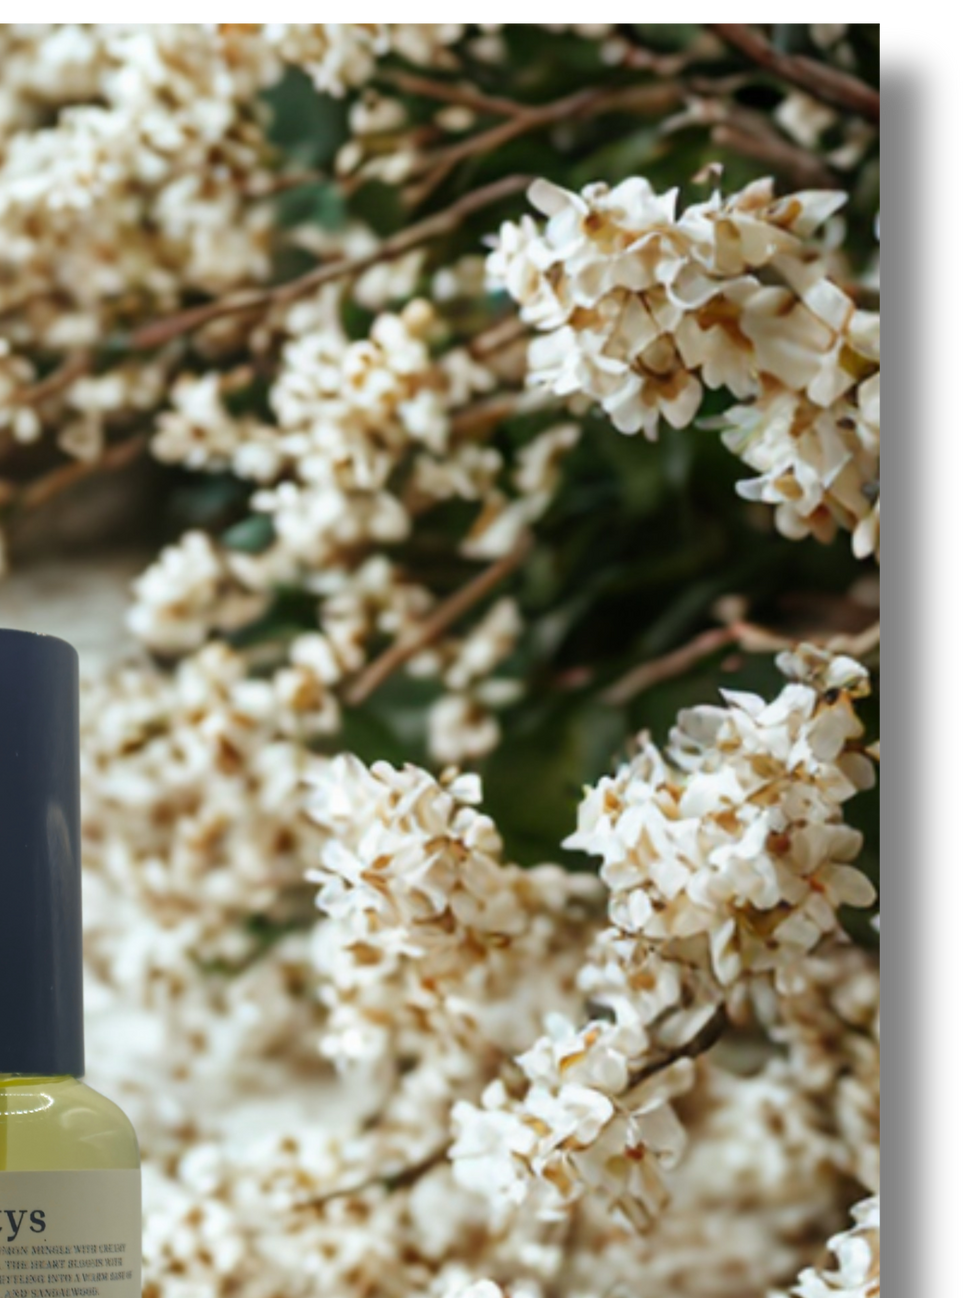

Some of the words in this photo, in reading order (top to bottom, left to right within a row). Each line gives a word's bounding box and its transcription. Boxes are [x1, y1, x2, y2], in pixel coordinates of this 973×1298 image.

[31, 1245, 71, 1255] MINGLE
[73, 1244, 97, 1254] WITH
[5, 1260, 27, 1270] THE
[30, 1260, 65, 1270] HEART
[47, 1273, 72, 1284] INTO
[74, 1273, 81, 1283] A
[82, 1272, 107, 1282] WARM
[4, 1289, 28, 1298] AND
[30, 1287, 99, 1298] SANDALWOOD.
